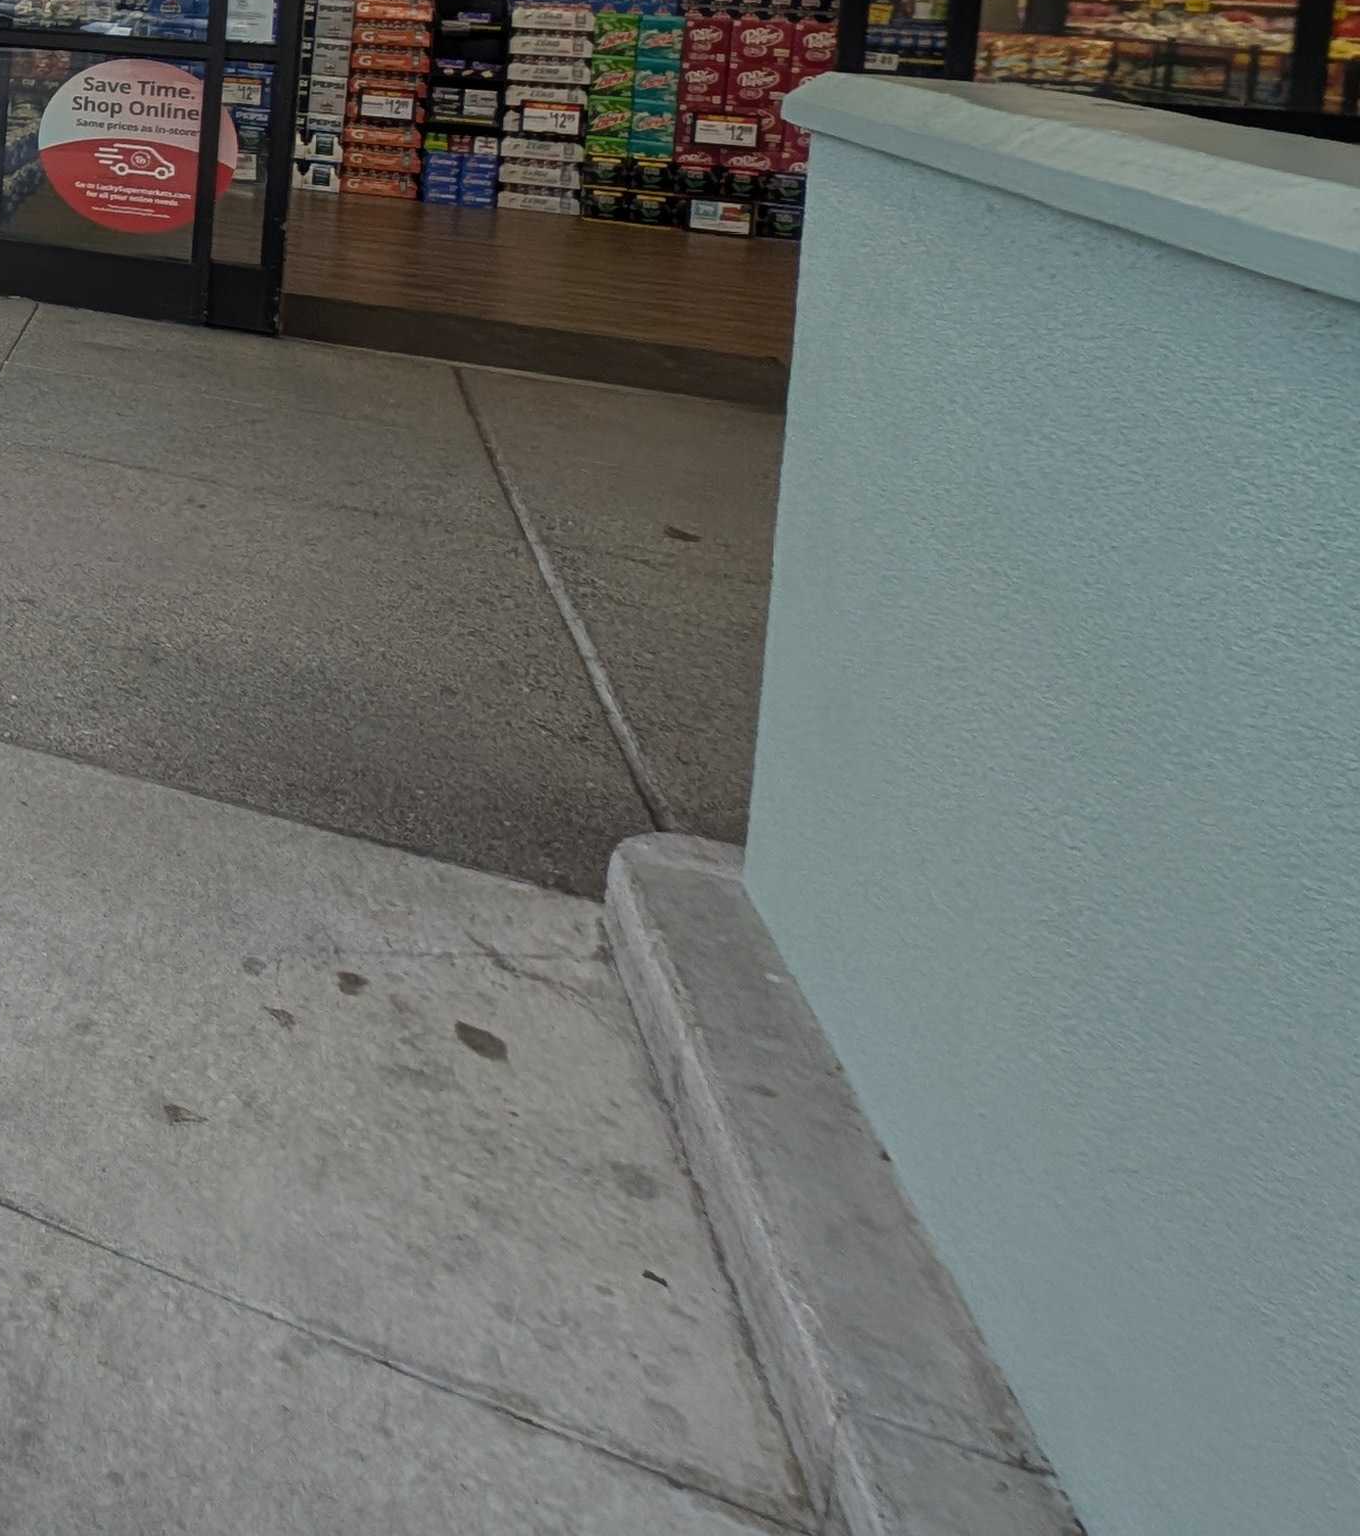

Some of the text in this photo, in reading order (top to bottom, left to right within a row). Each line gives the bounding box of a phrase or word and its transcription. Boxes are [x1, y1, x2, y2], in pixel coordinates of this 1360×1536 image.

[83, 76, 195, 100] Save Time.
[72, 96, 200, 121] Shop Online
[76, 118, 105, 128] Same
[107, 121, 139, 131] prices
[140, 125, 153, 133] as
